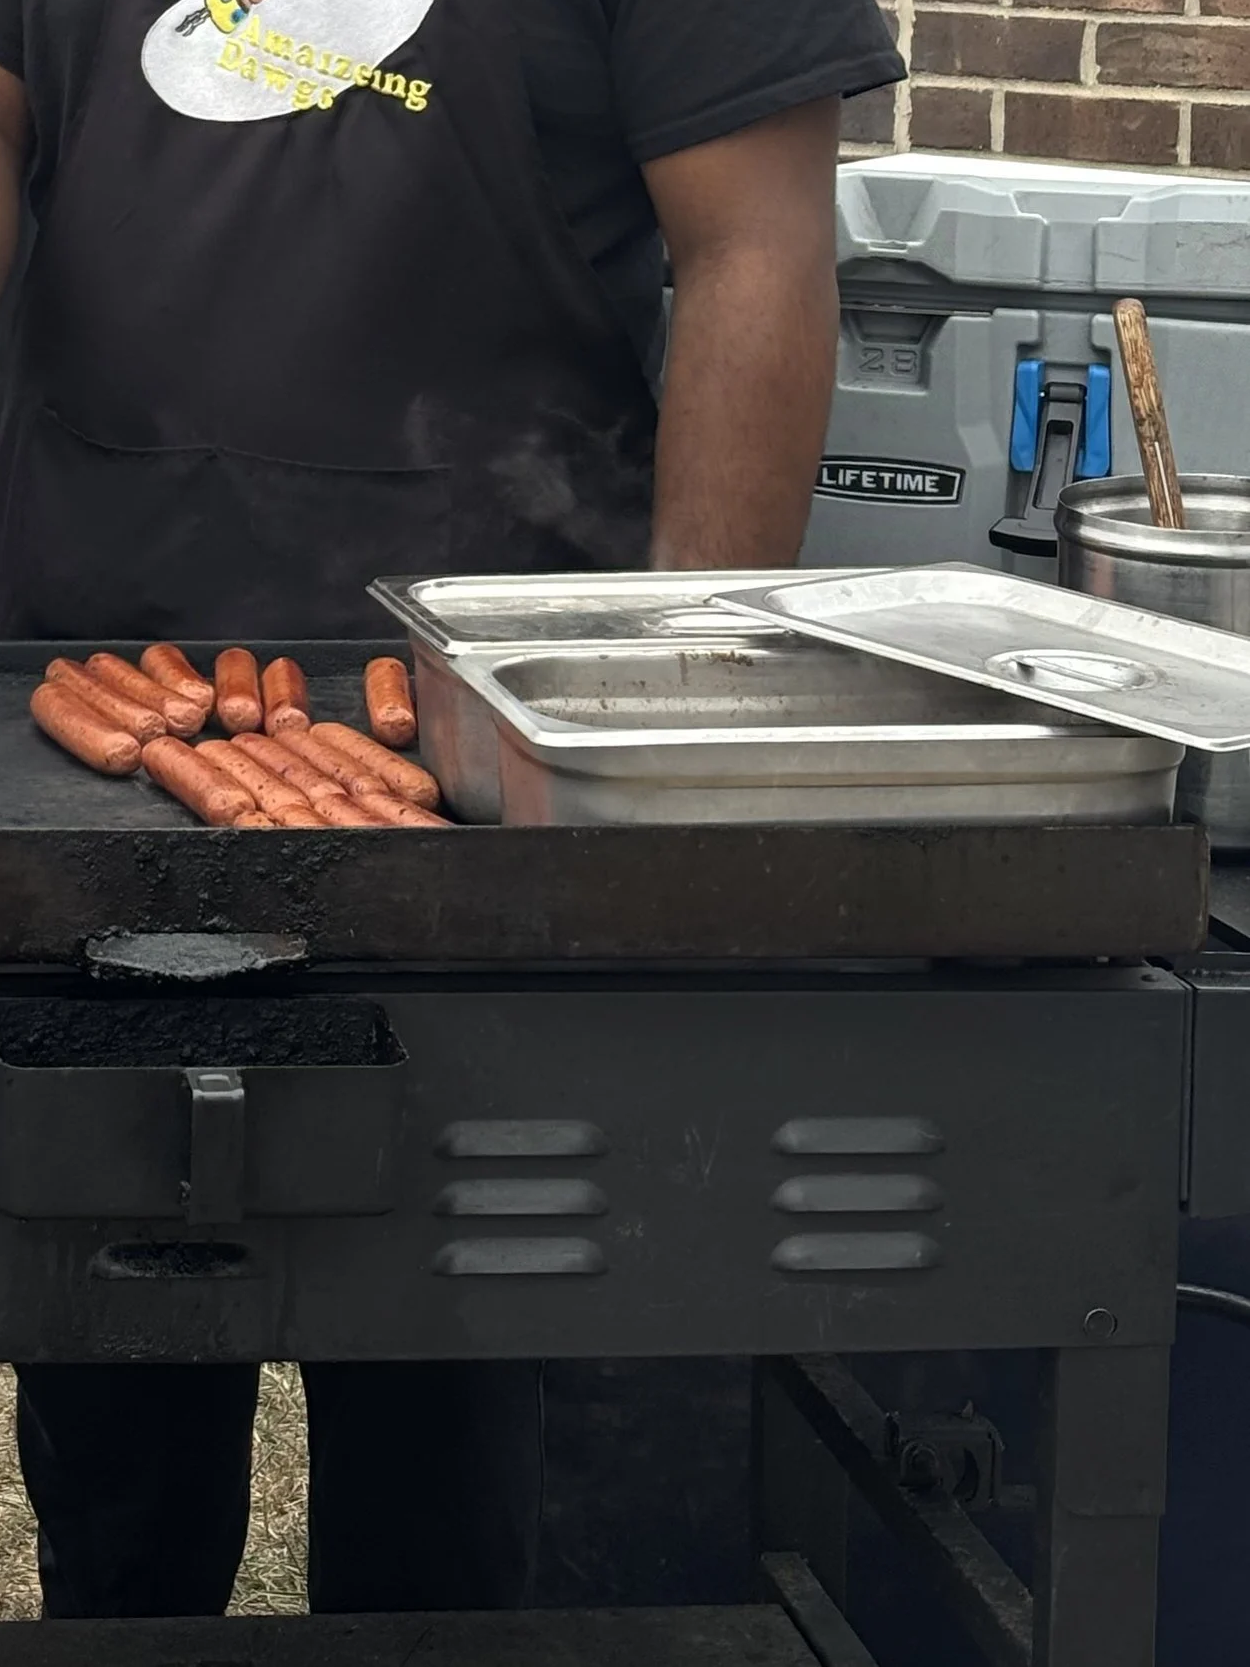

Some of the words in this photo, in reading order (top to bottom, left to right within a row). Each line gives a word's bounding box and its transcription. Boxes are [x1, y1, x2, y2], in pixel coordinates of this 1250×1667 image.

[216, 37, 335, 110] Dawgs
[859, 347, 918, 376] 28
[822, 467, 940, 493] LIFETIME
